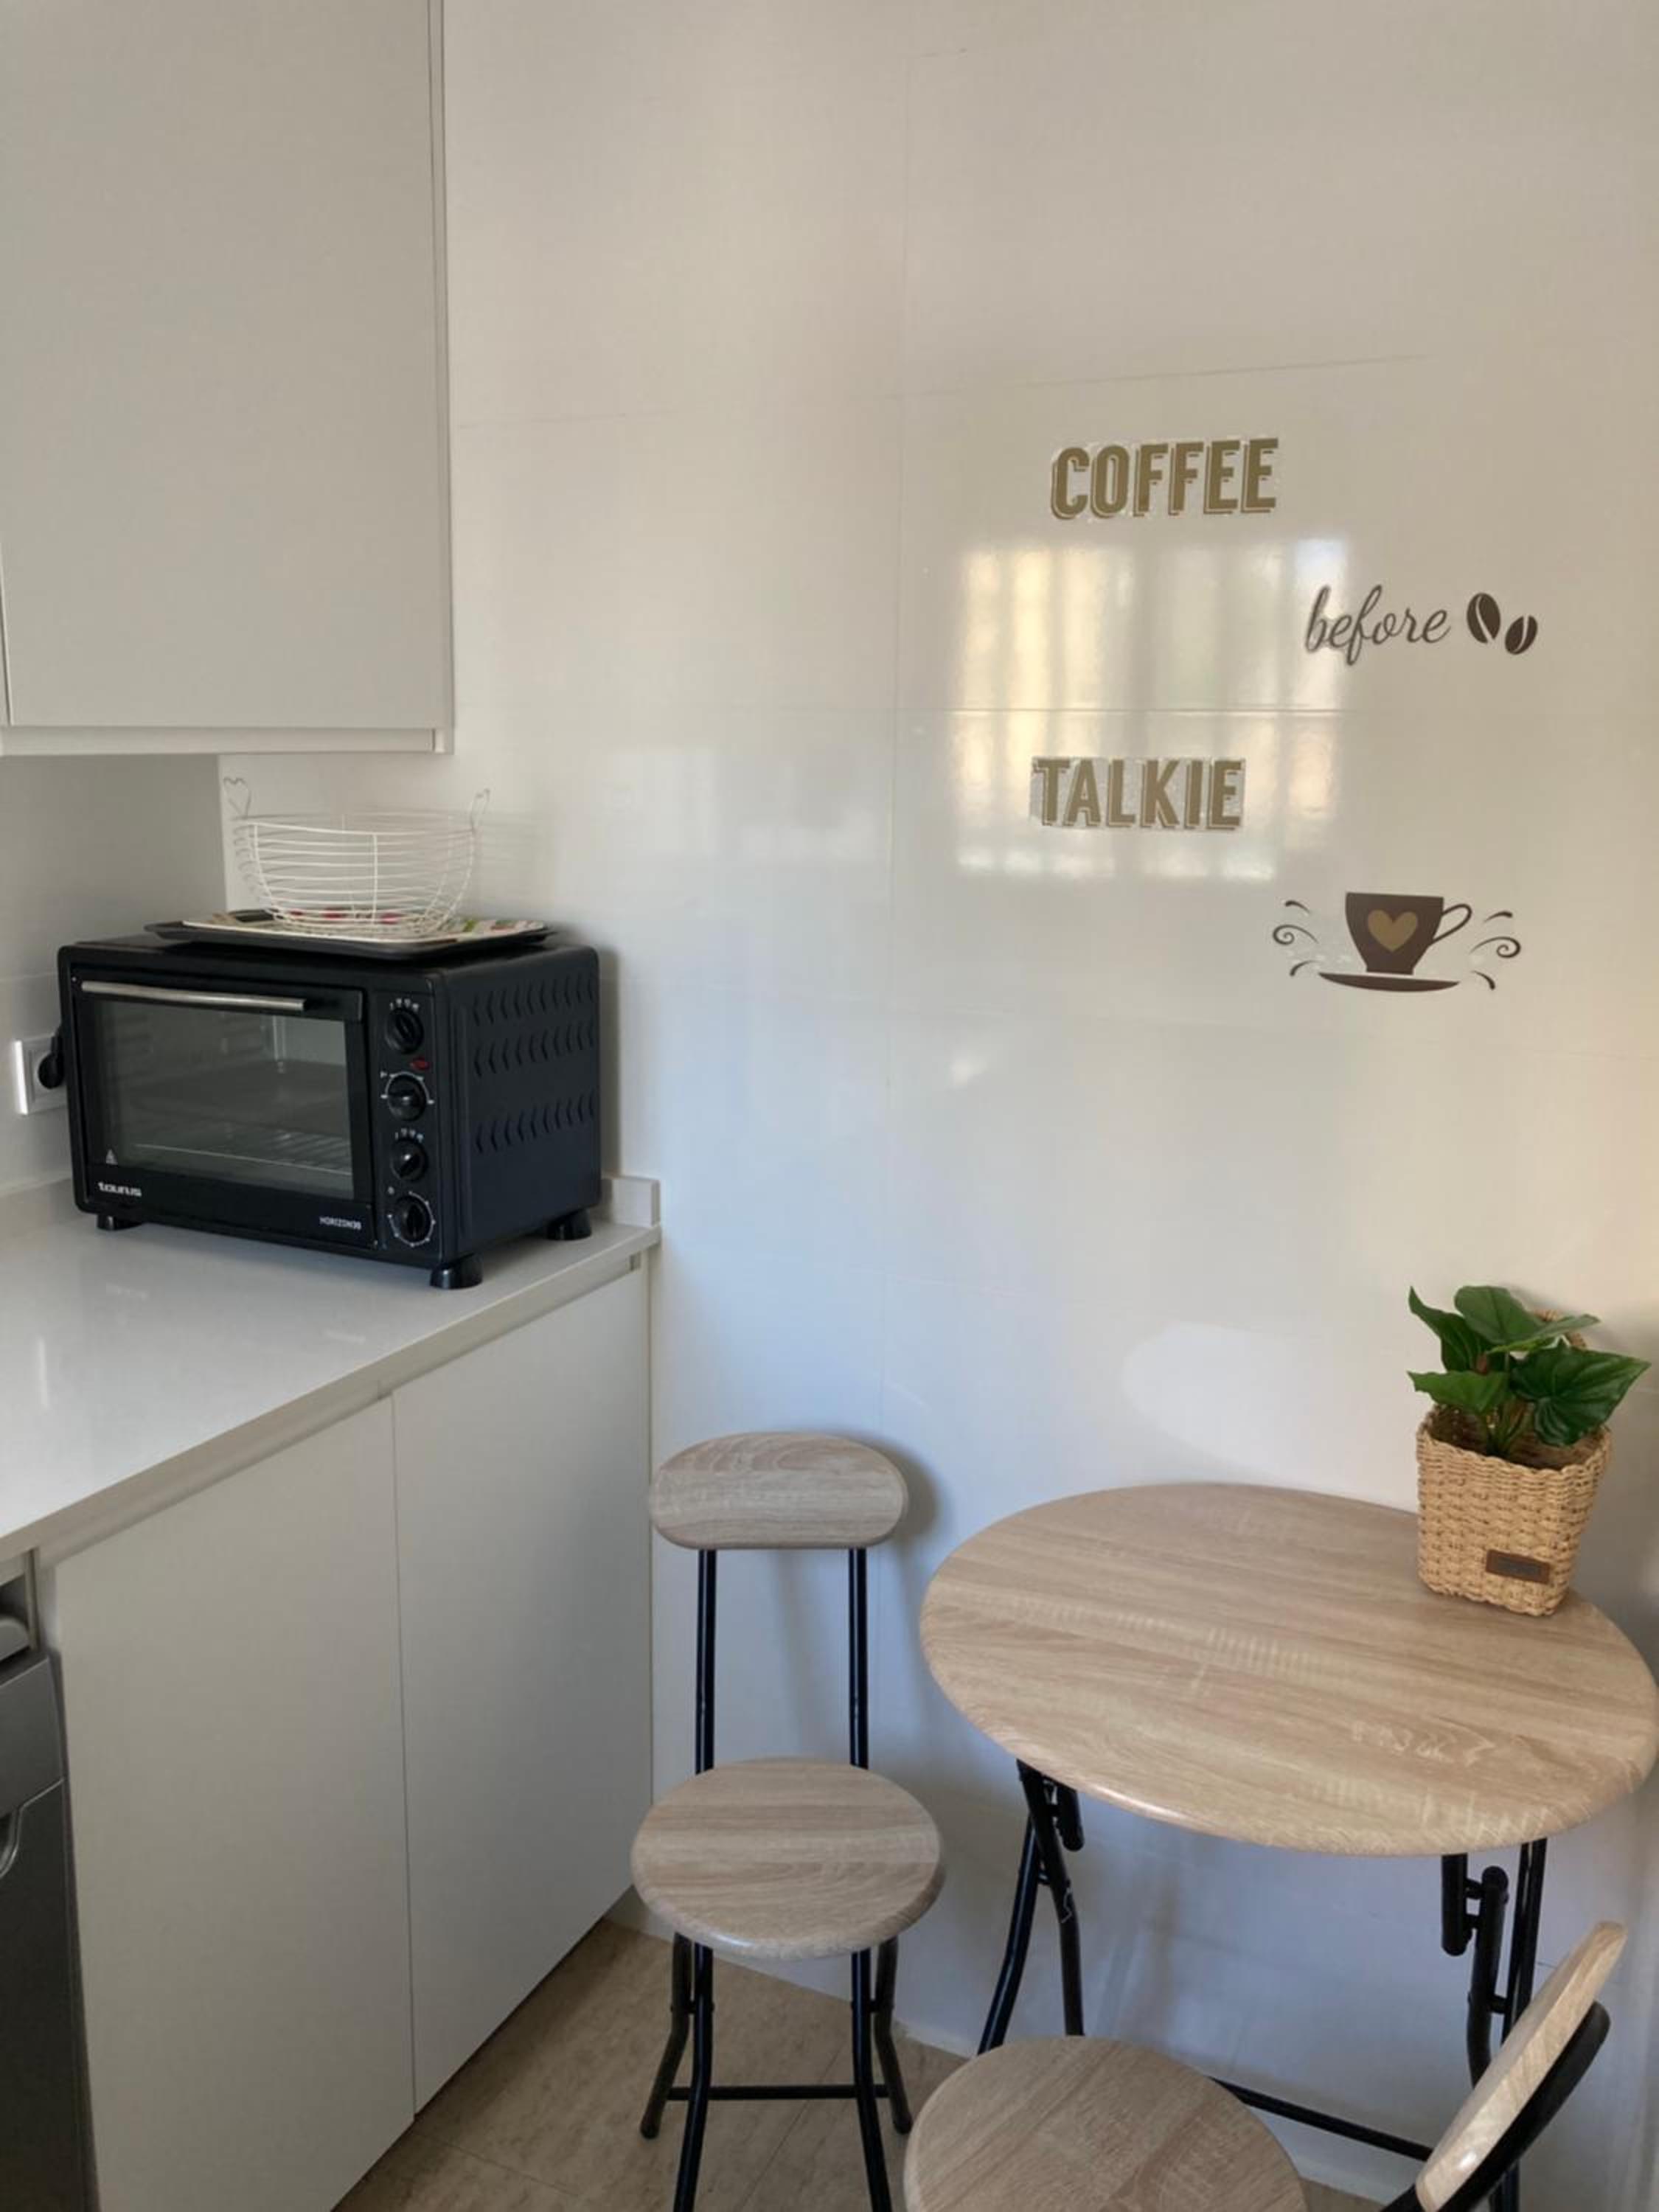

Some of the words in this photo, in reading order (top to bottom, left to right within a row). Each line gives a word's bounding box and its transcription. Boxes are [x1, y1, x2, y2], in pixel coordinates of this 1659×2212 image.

[1050, 438, 1279, 521] COFFEE
[1305, 585, 1451, 665] before
[1032, 759, 1243, 831] TALKIE
